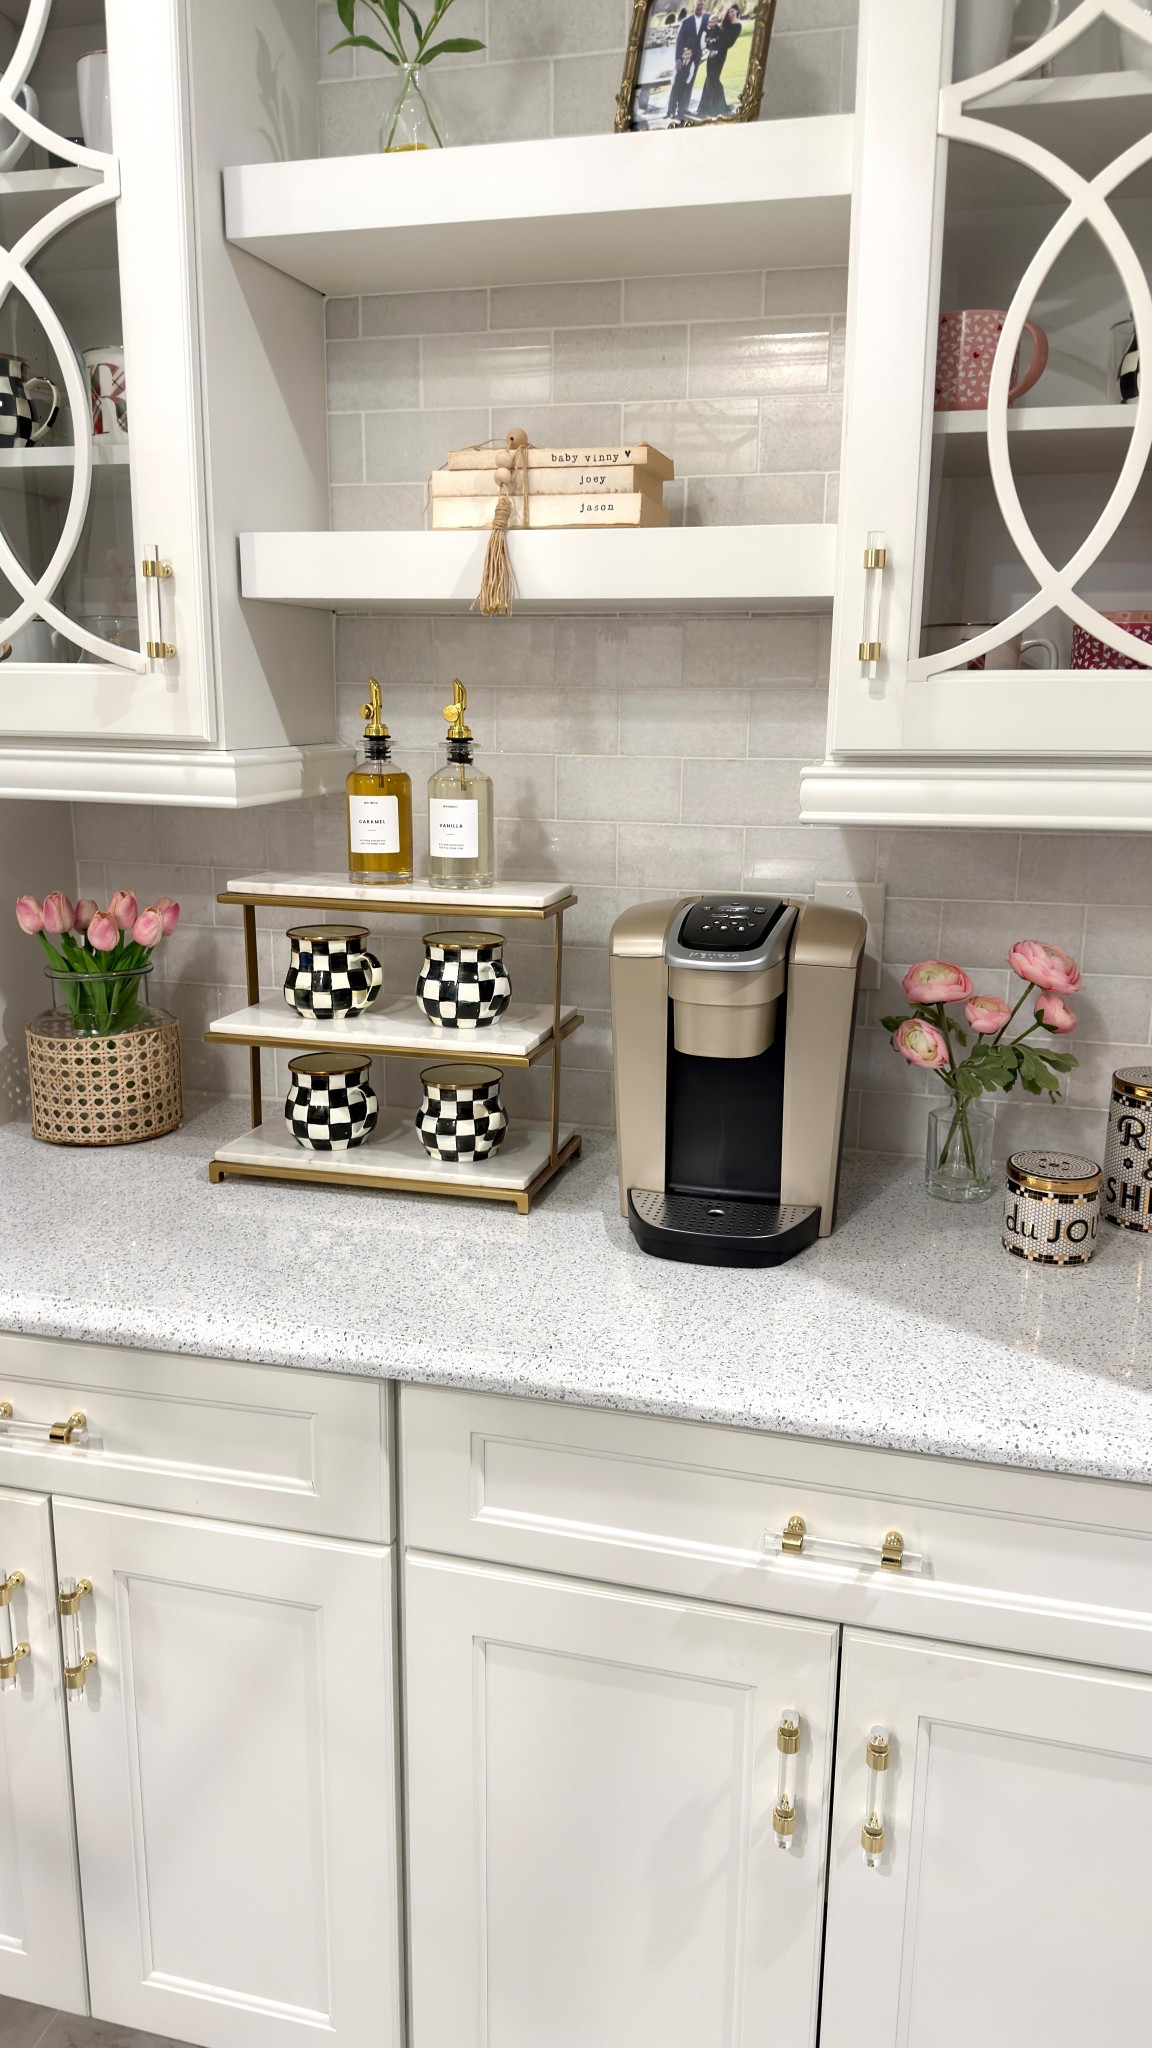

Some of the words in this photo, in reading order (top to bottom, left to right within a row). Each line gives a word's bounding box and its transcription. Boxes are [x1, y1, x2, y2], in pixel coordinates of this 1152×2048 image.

[87, 363, 128, 436] R
[551, 453, 578, 463] baby
[585, 453, 619, 463] vinny
[579, 475, 606, 485] joey
[580, 503, 614, 513] jason
[1006, 1204, 1038, 1240] du
